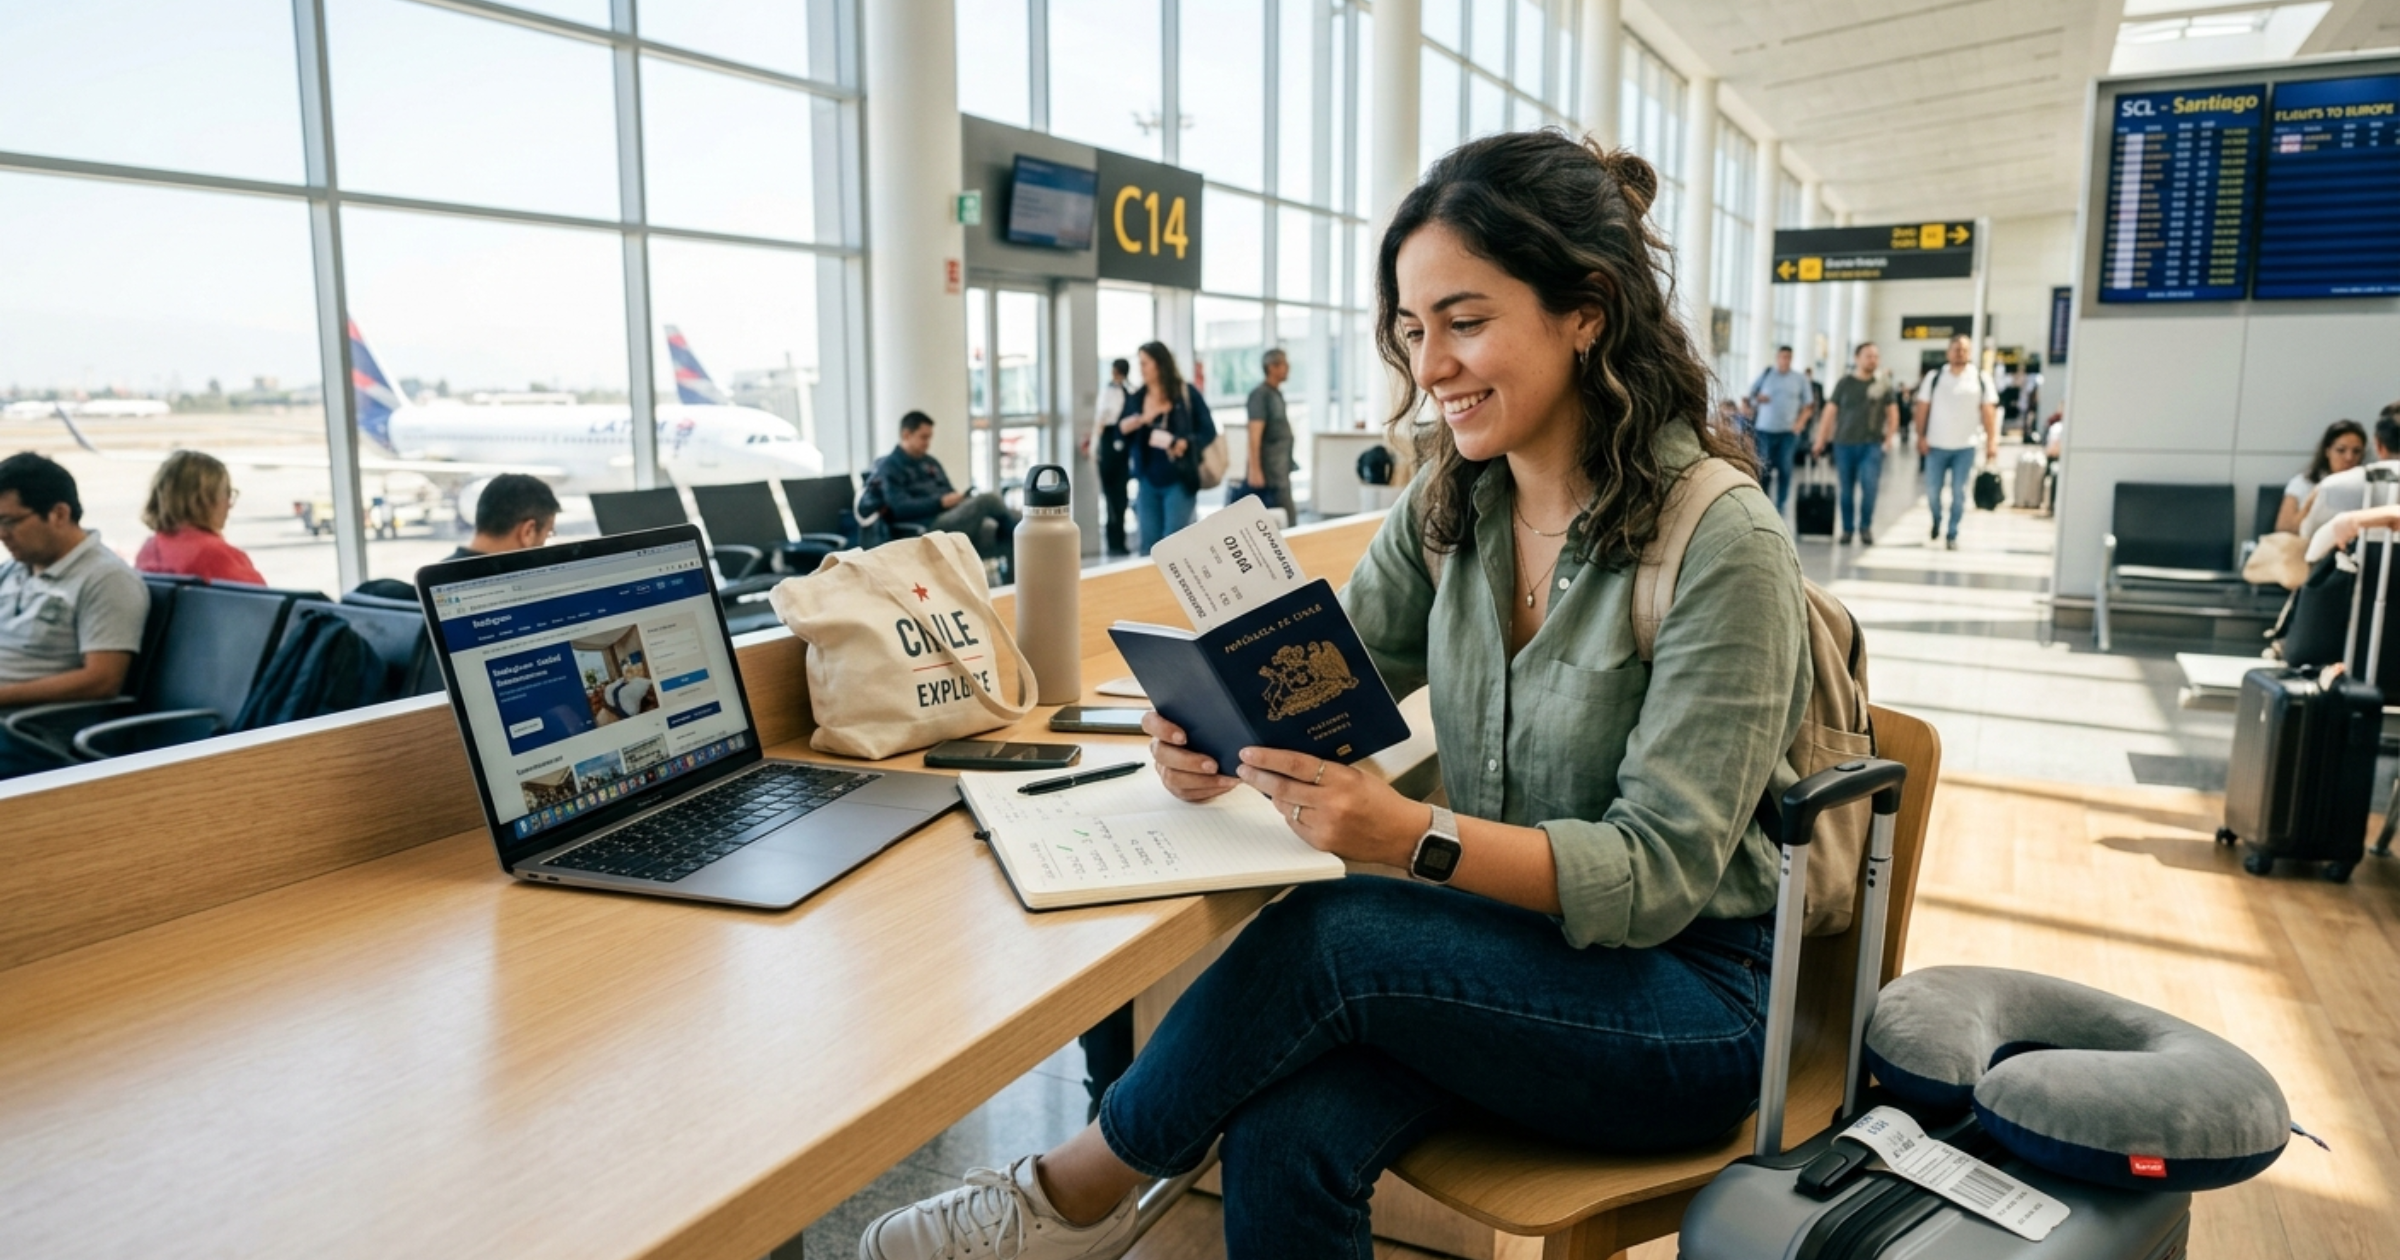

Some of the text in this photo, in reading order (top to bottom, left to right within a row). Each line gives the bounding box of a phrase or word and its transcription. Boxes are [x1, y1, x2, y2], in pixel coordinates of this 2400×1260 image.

[2121, 98, 2157, 117] SCL
[2172, 94, 2259, 114] Santiago
[1113, 185, 1189, 259] C14
[916, 670, 991, 708] EXPLOE
